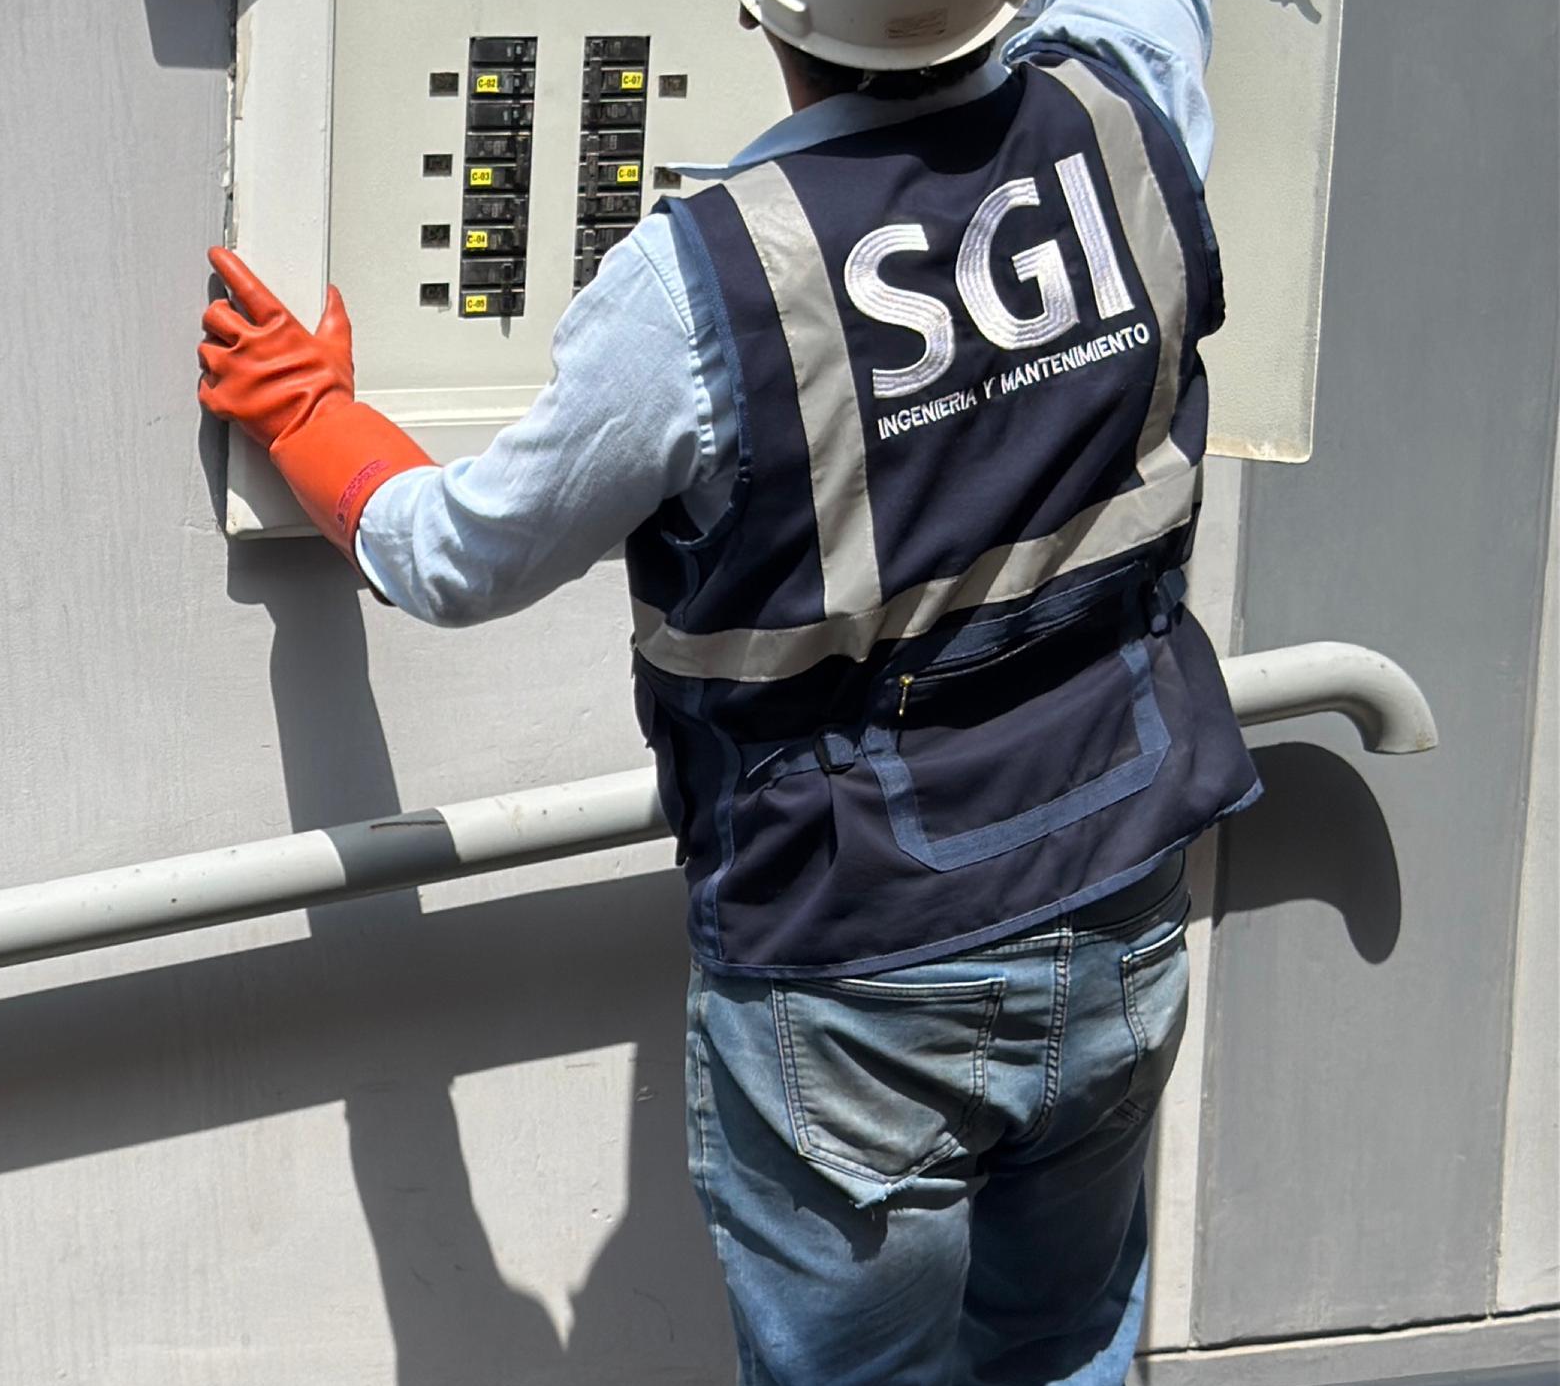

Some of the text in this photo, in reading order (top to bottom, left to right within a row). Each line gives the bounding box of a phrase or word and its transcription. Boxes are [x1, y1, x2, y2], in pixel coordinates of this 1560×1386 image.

[477, 78, 496, 89] C-02
[622, 75, 642, 85] C-07
[471, 172, 490, 182] C-03
[466, 234, 486, 245] C-04
[844, 152, 1135, 399] SGI
[877, 322, 1150, 440] INGENIERIA Y MANTENIMIENTO
